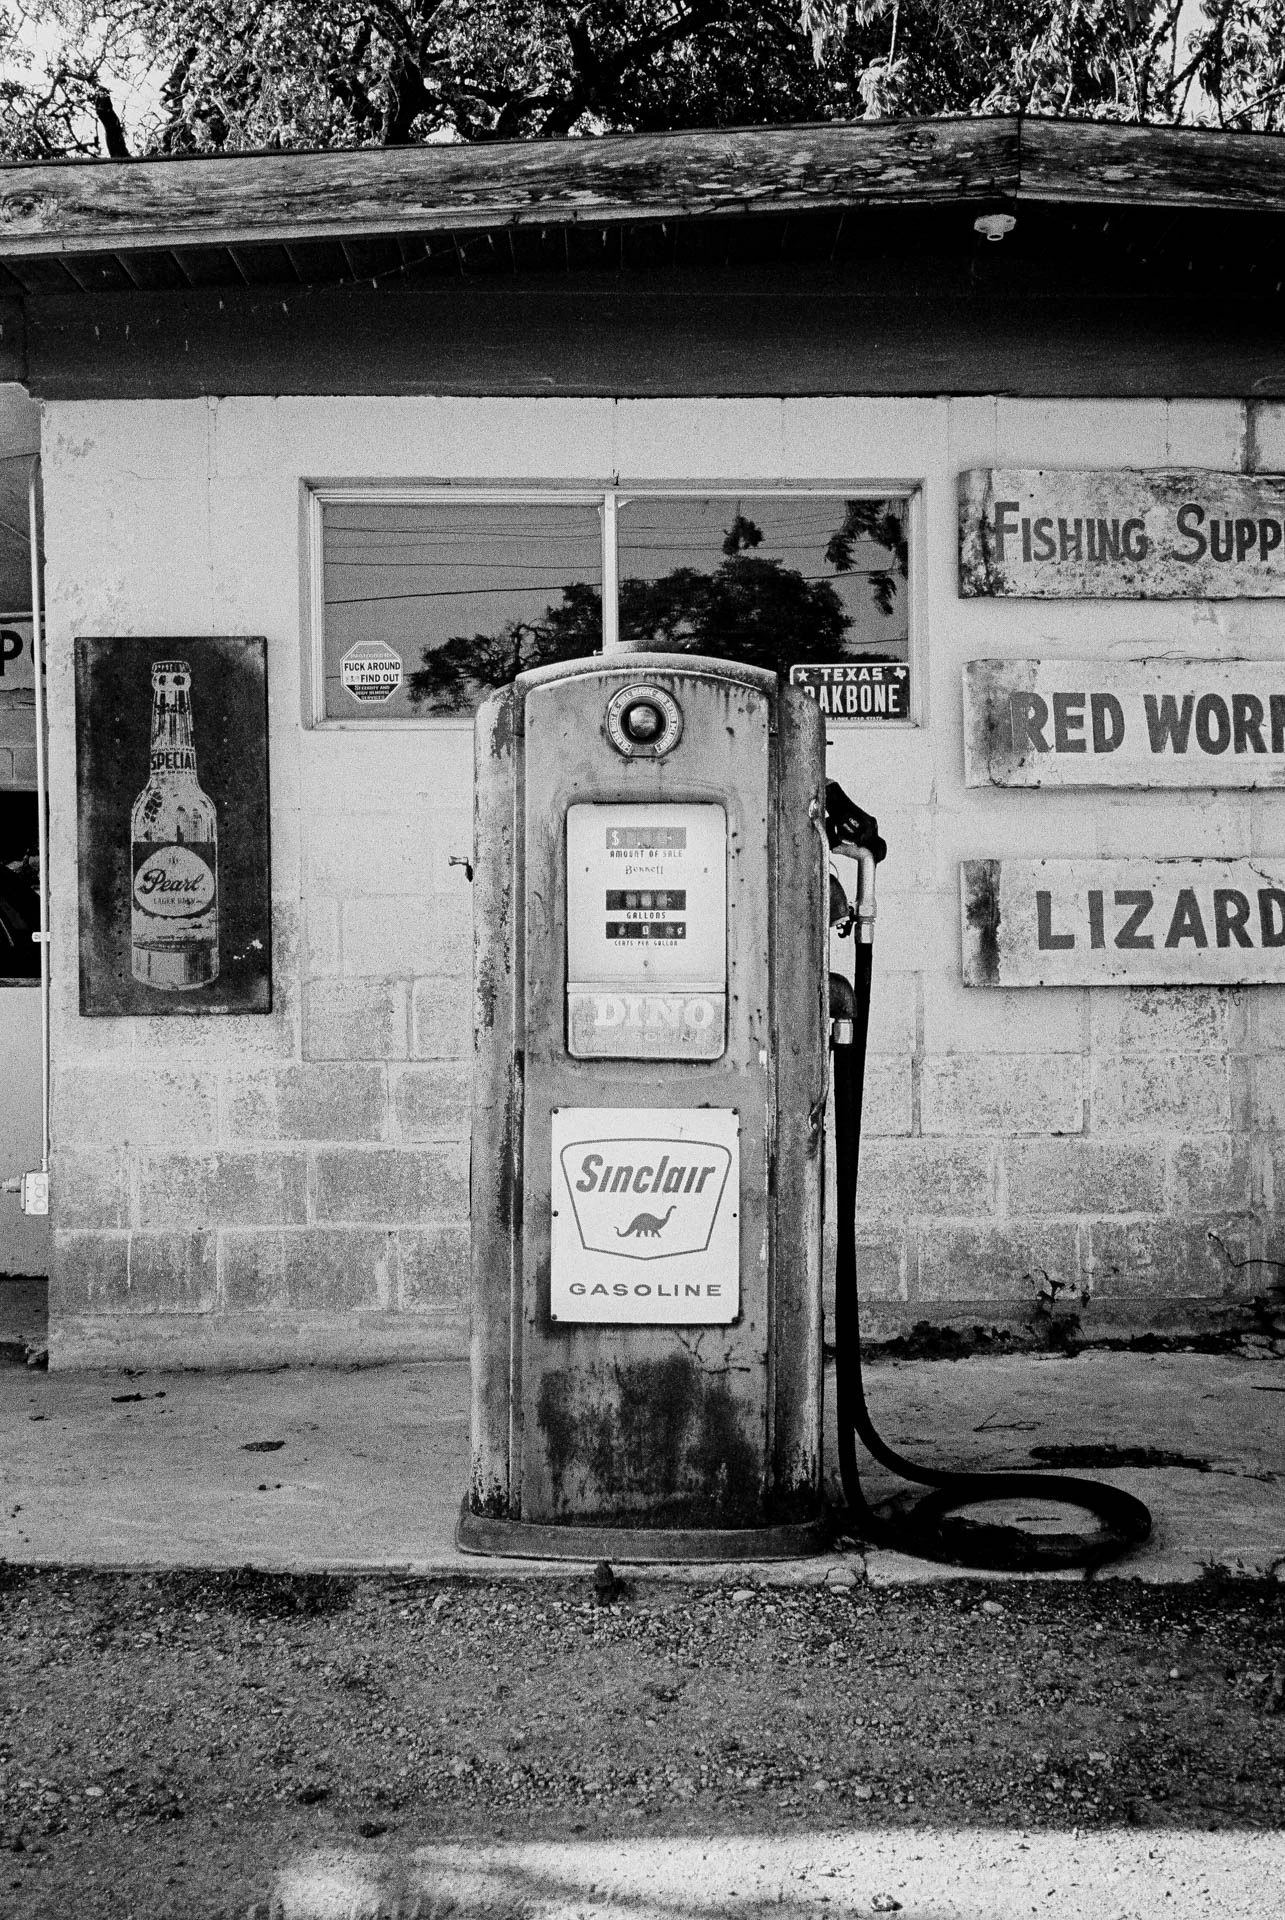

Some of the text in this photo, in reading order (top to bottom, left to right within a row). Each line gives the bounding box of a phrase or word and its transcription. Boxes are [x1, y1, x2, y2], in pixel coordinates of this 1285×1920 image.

[996, 501, 1285, 562] FISHING SUPP
[344, 662, 401, 671] FUCK AROUND
[360, 673, 399, 682] FIND OUT
[821, 667, 883, 681] TEXAS
[1006, 693, 1126, 753] RED
[610, 850, 682, 858] AMOUNT OF SALE
[138, 868, 204, 895] Pearl
[1036, 888, 1285, 949] LIZARD
[594, 998, 715, 1029] DINO
[576, 1154, 716, 1194] Sinclair
[569, 1282, 722, 1297] GASOLINE
